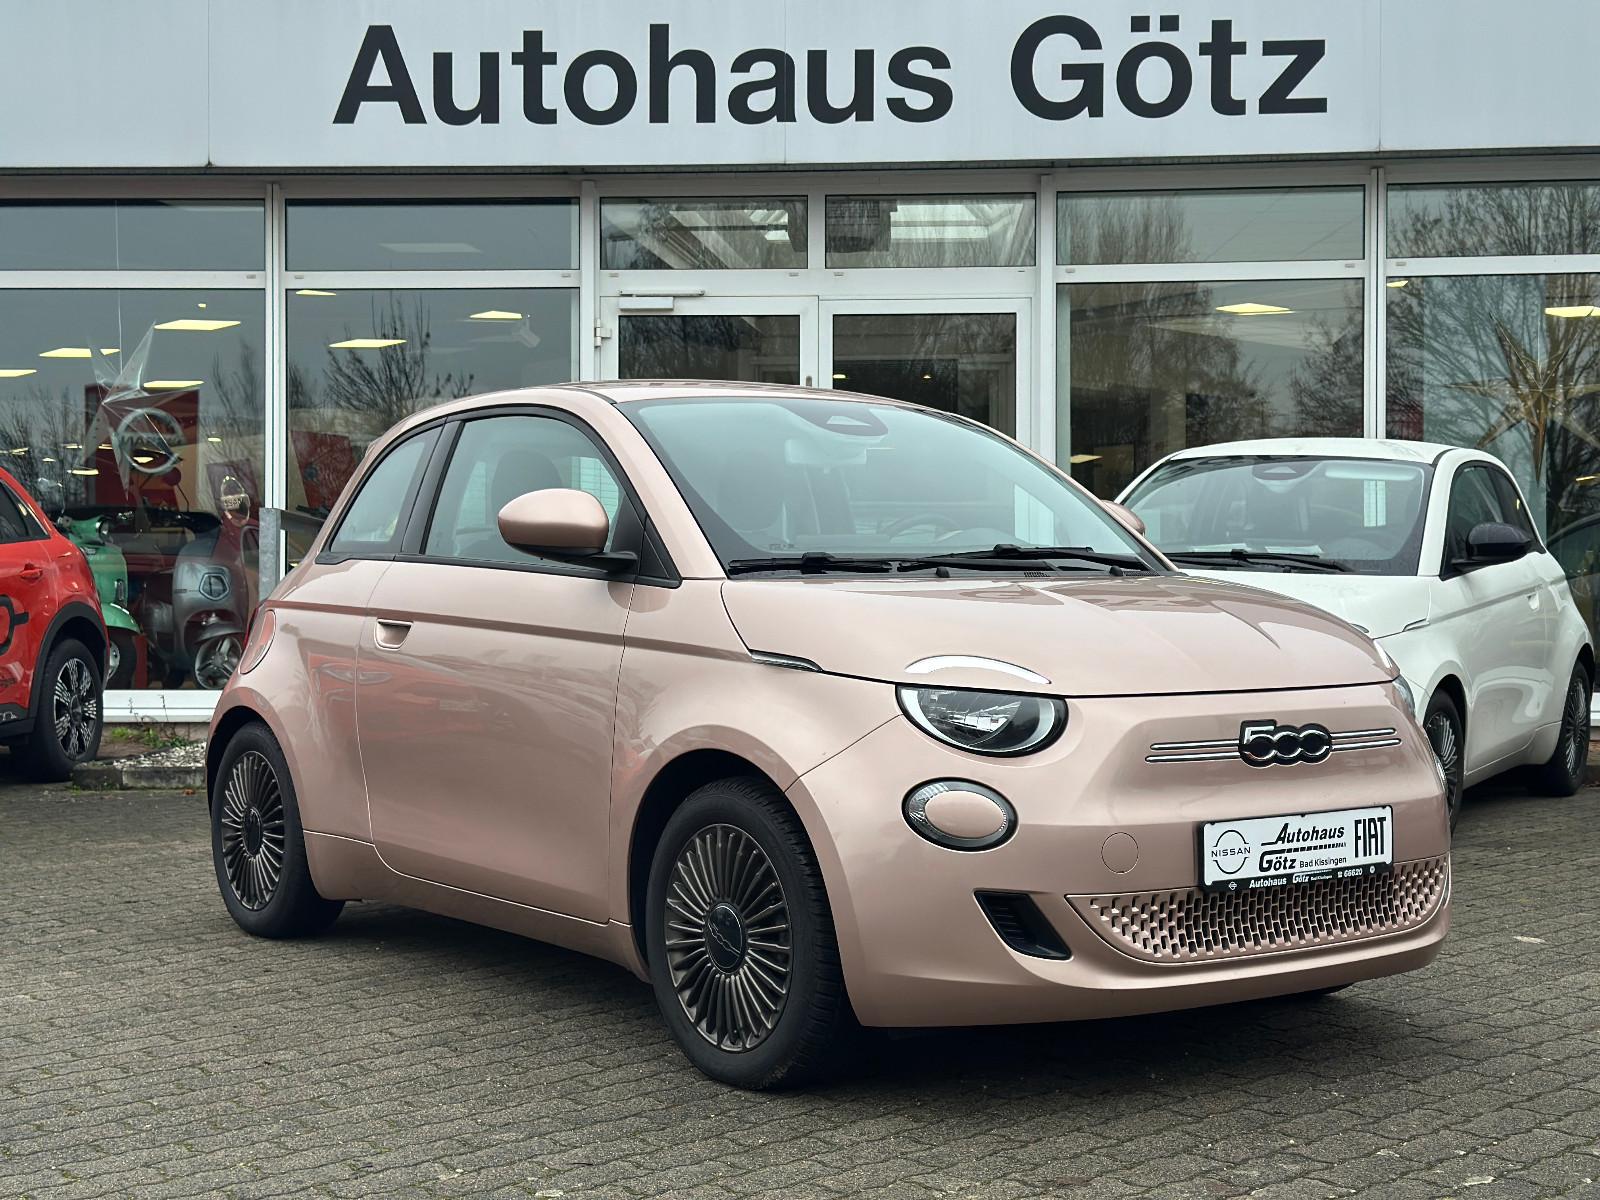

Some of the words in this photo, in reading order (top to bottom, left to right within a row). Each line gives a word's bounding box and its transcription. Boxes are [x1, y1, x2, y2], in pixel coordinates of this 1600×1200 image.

[332, 23, 953, 126] Autohaus
[1010, 14, 1328, 120] Götz
[1240, 719, 1332, 768] 500
[1261, 822, 1345, 846] Autohaus
[1354, 816, 1387, 858] FIAT
[1211, 846, 1251, 858] NISSAN
[1259, 849, 1297, 873] Götz
[1299, 858, 1314, 869] Bad
[1314, 856, 1347, 867] Kissingen
[1249, 878, 1287, 889] Autohaus
